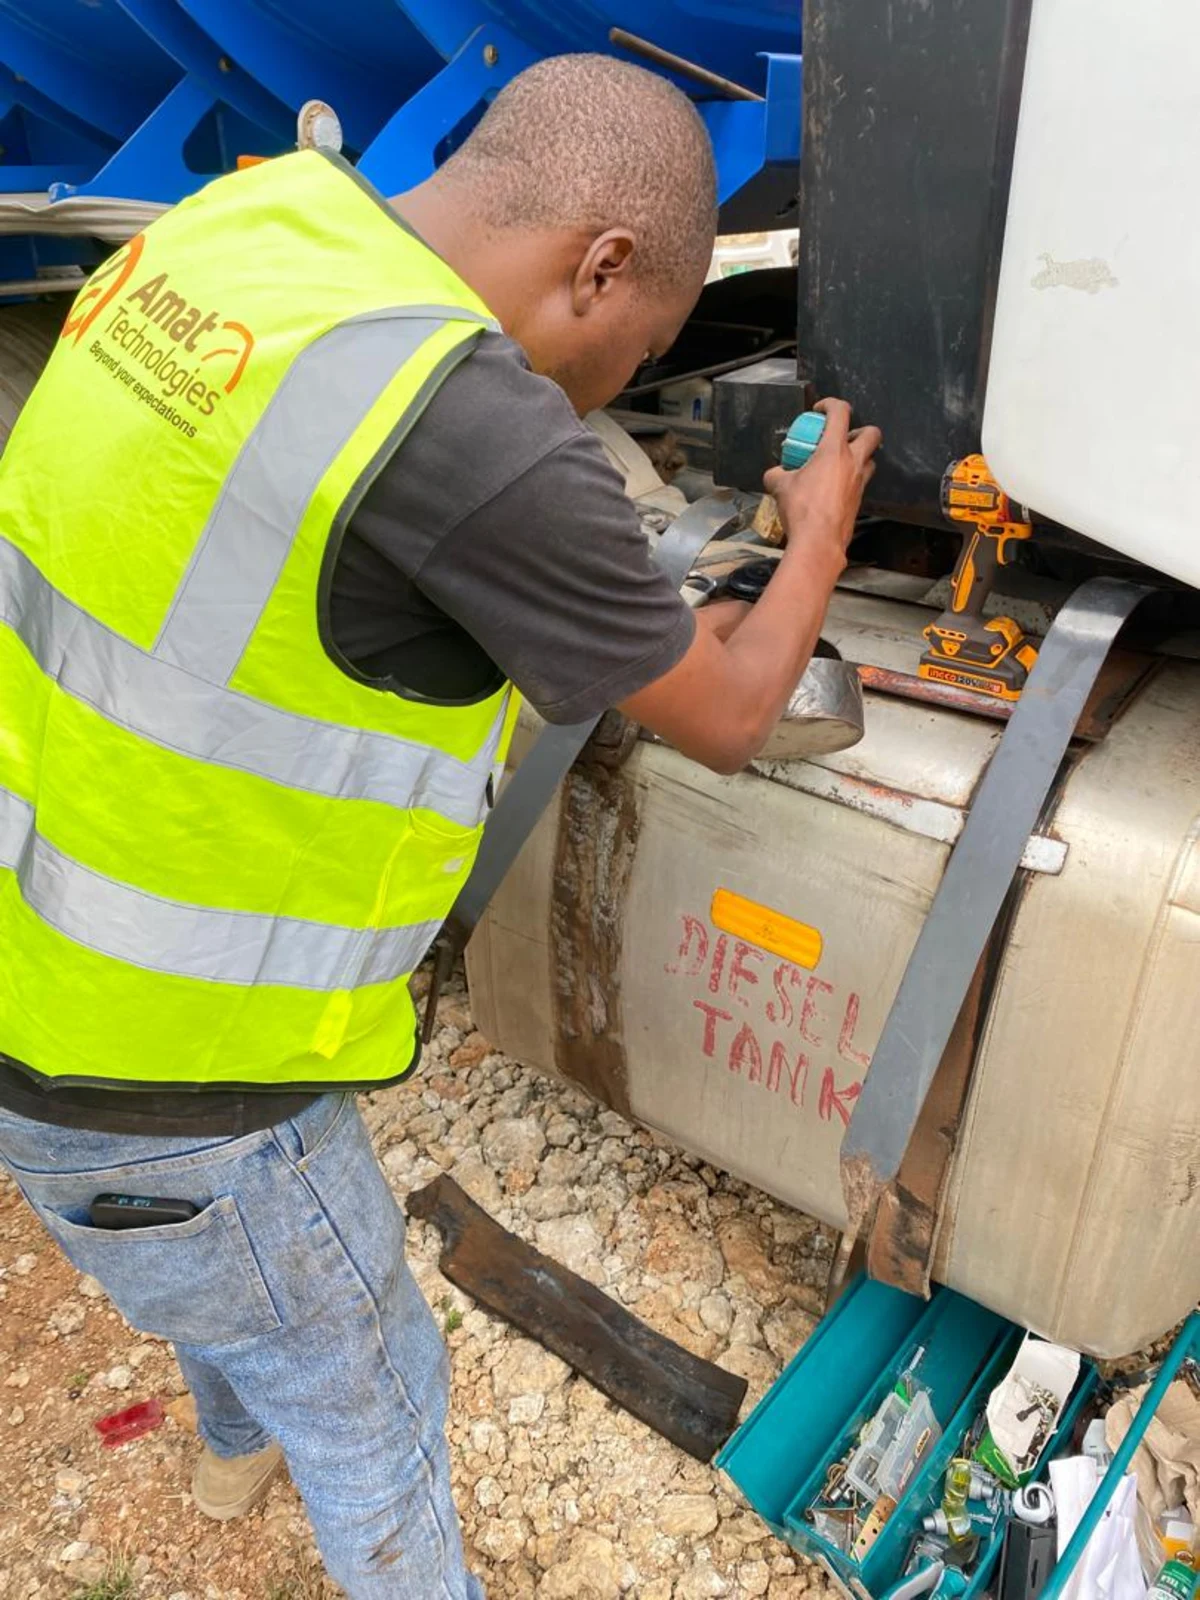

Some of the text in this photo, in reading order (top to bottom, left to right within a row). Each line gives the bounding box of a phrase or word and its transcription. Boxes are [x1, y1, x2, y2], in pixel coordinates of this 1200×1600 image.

[104, 306, 221, 416] Technologies
[126, 272, 220, 353] Amat
[89, 340, 198, 438] Beyond your expectations
[663, 915, 871, 1067] DIESEL
[693, 999, 863, 1127] TANK
